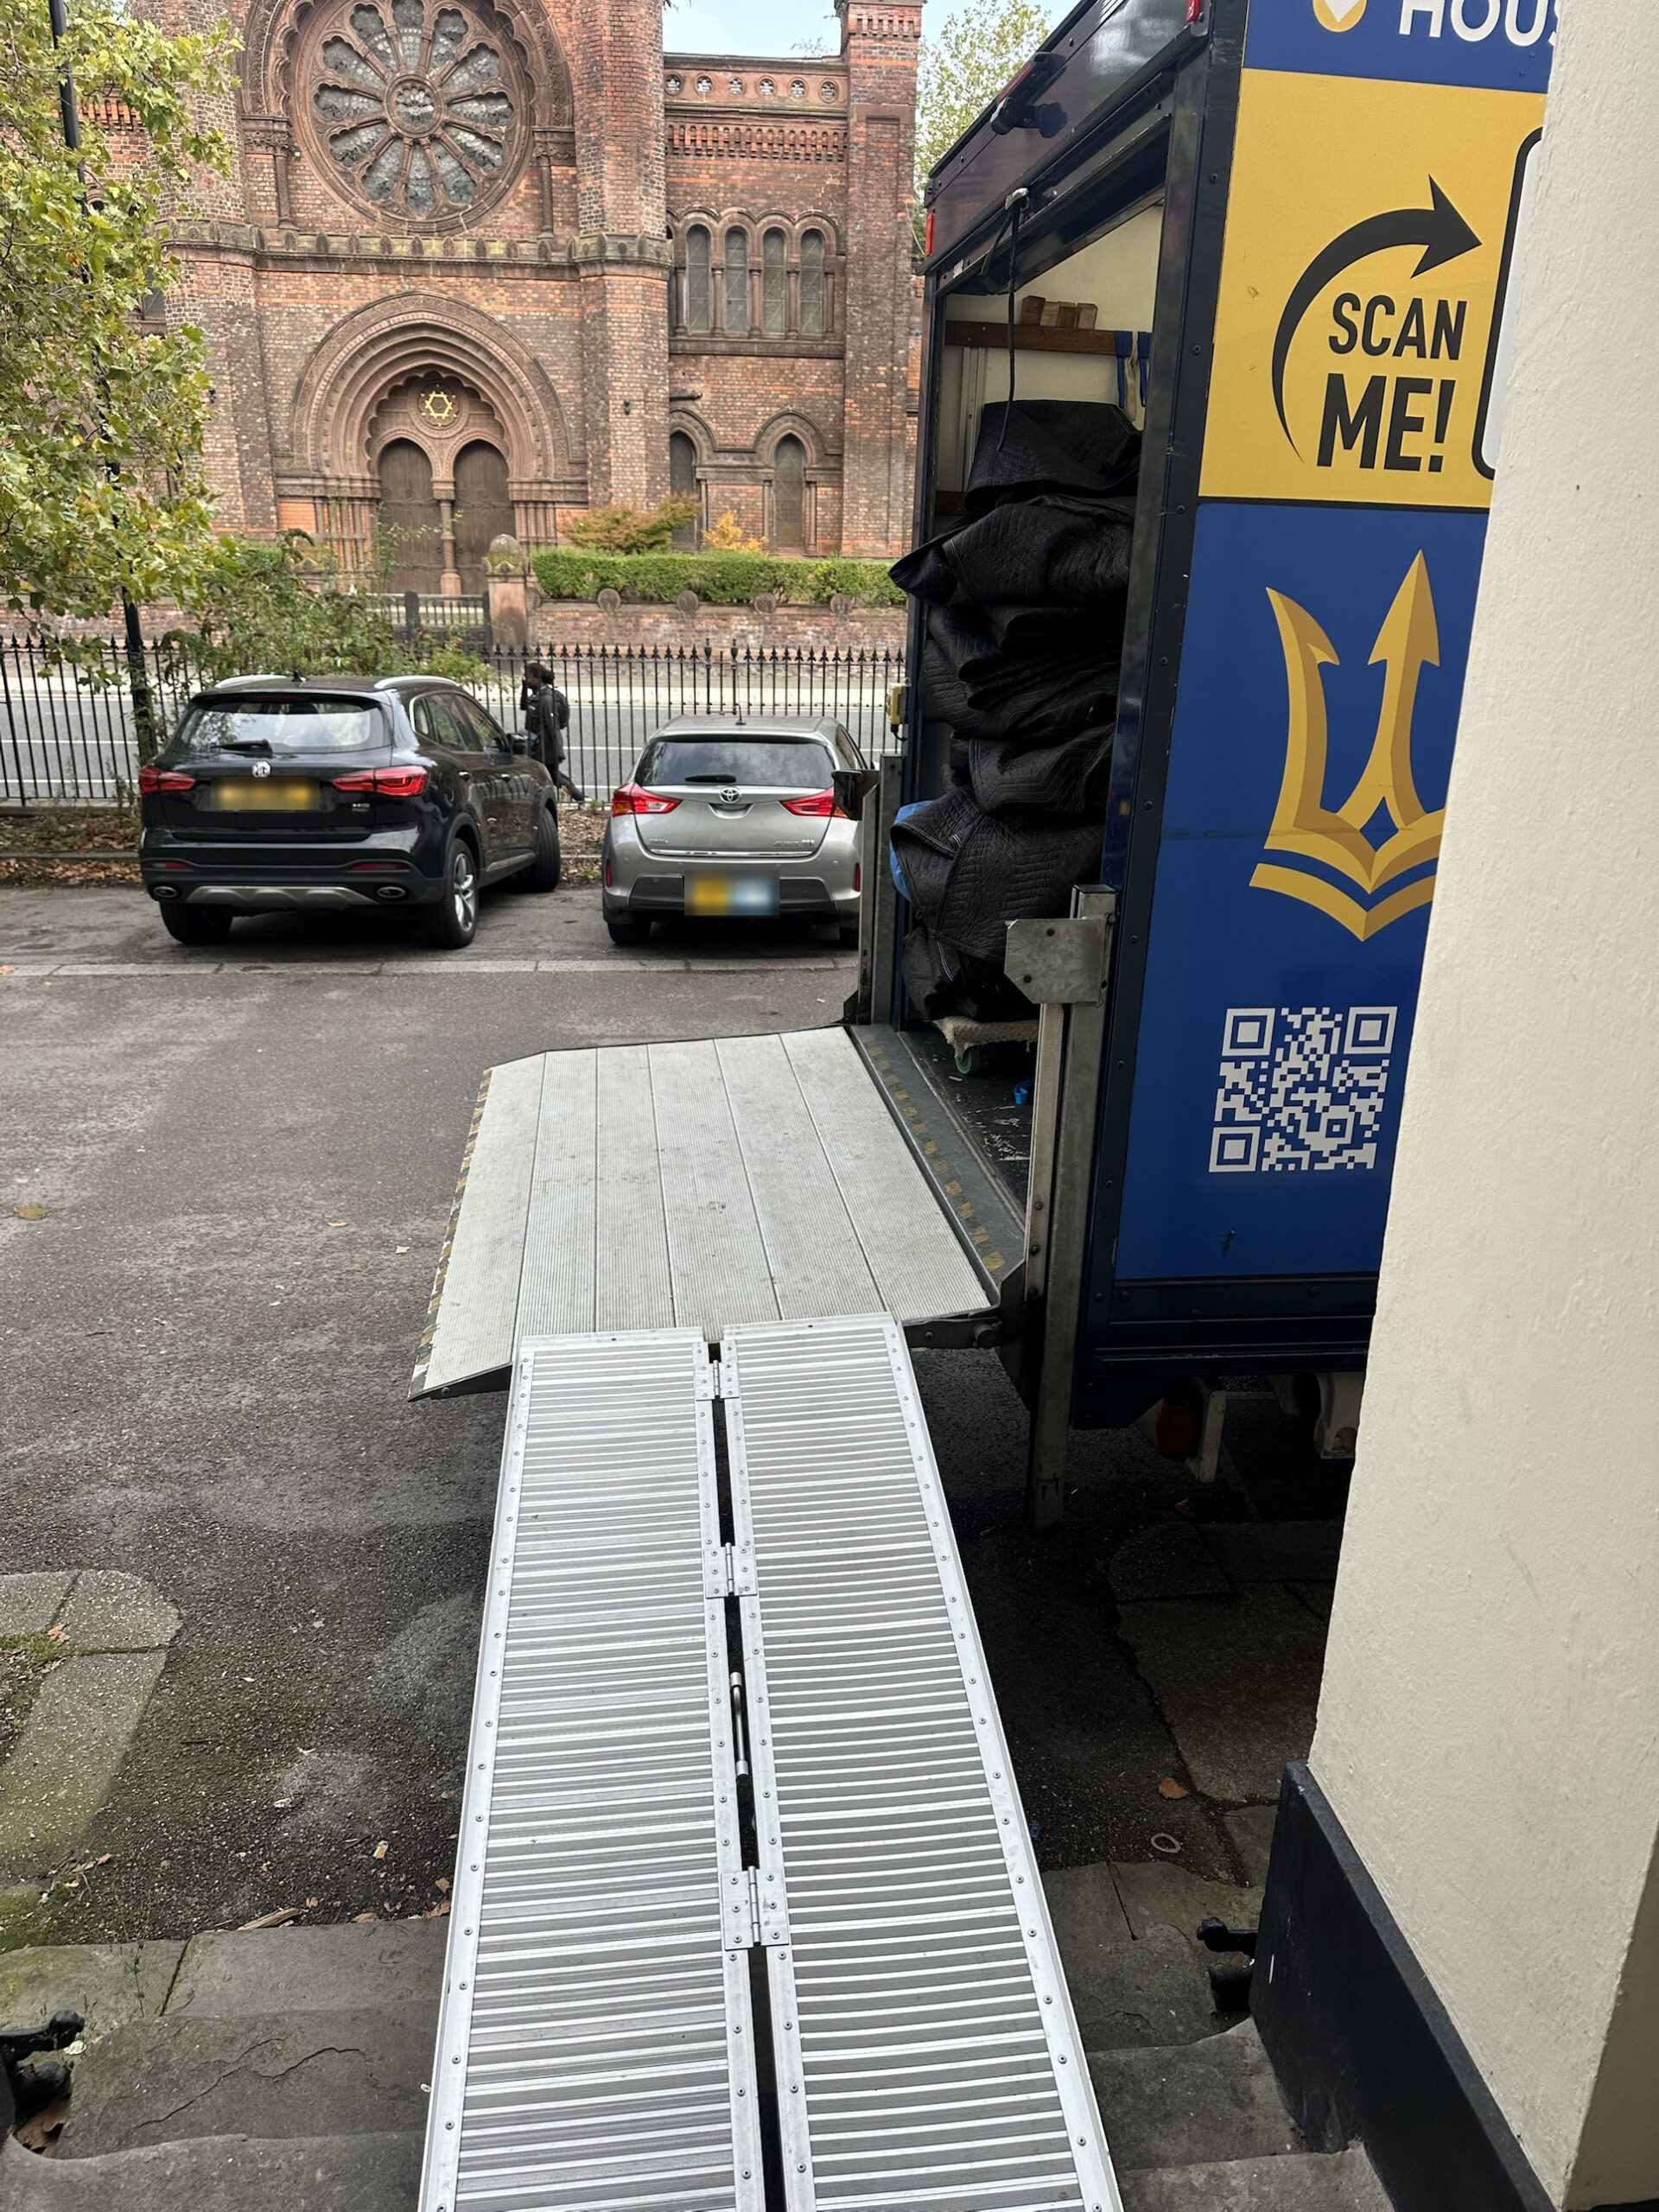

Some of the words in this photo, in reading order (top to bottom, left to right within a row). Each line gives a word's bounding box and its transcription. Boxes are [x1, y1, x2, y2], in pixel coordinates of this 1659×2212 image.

[1399, 0, 1559, 46] HOU
[1329, 292, 1467, 361] SCAN
[1316, 372, 1456, 473] ME!
